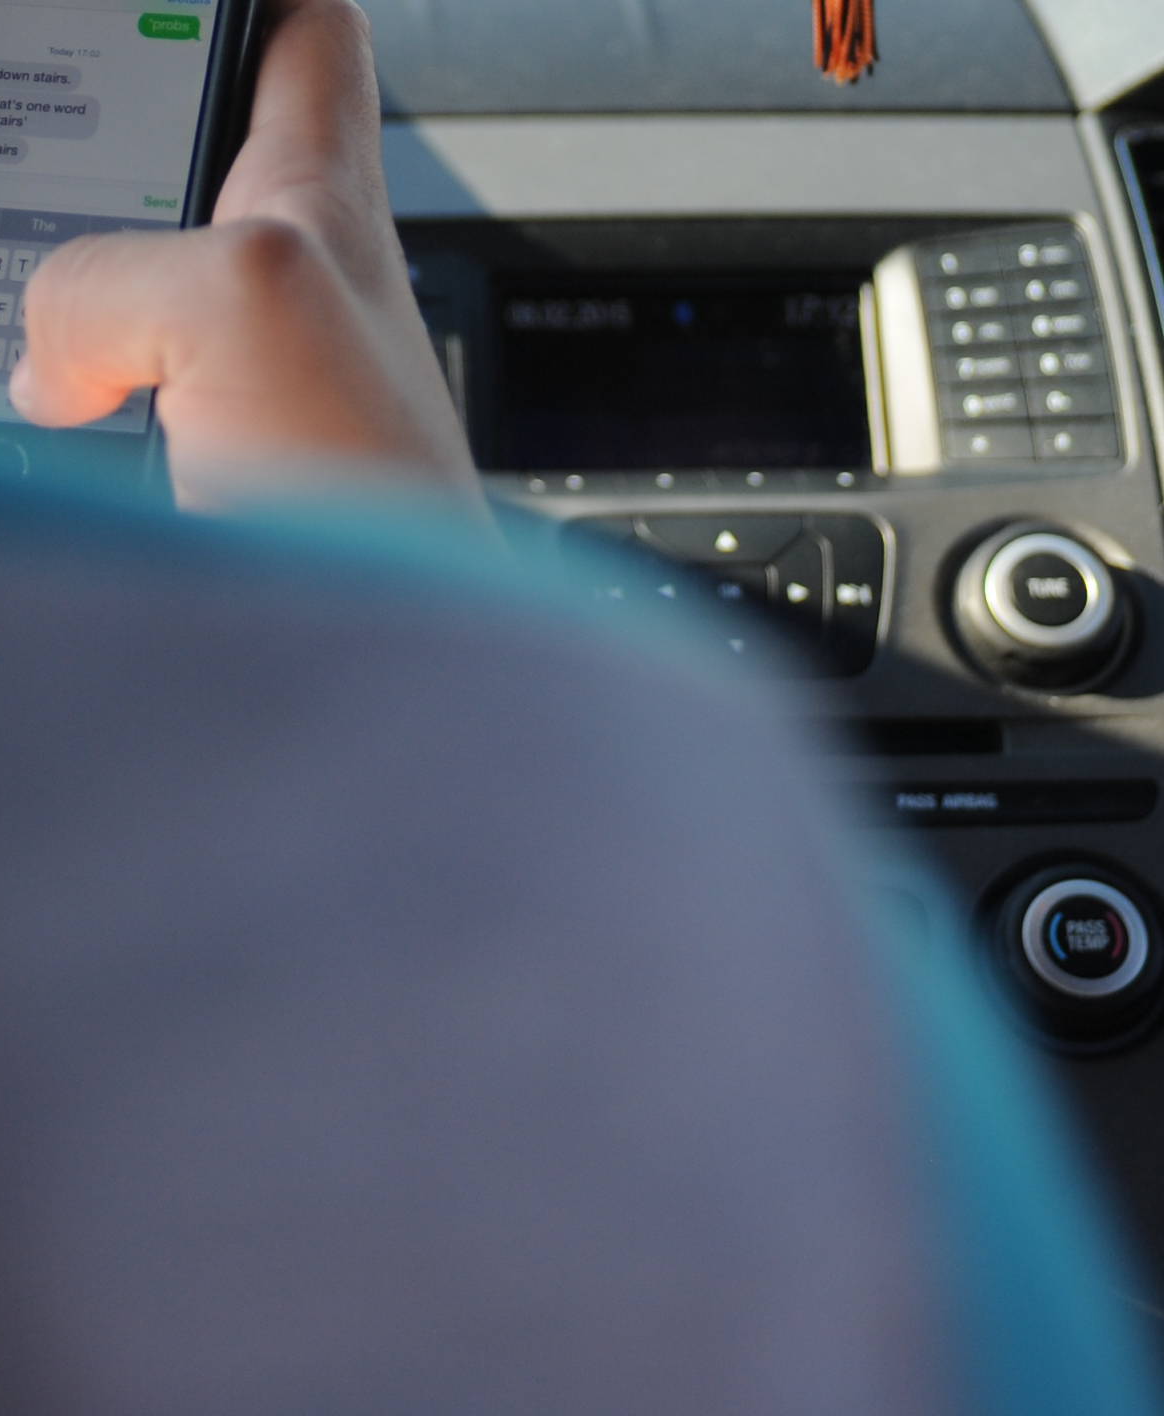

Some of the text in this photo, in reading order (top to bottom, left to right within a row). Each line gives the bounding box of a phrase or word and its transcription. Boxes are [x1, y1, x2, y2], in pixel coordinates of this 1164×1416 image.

[48, 46, 75, 59] Today
[33, 72, 72, 85] stairs.
[26, 102, 51, 114] one
[53, 103, 87, 116] word
[143, 195, 178, 210] Send
[31, 218, 56, 233] The
[18, 259, 29, 274] T
[1066, 919, 1107, 935] PASS
[1069, 935, 1110, 951] TEMP
